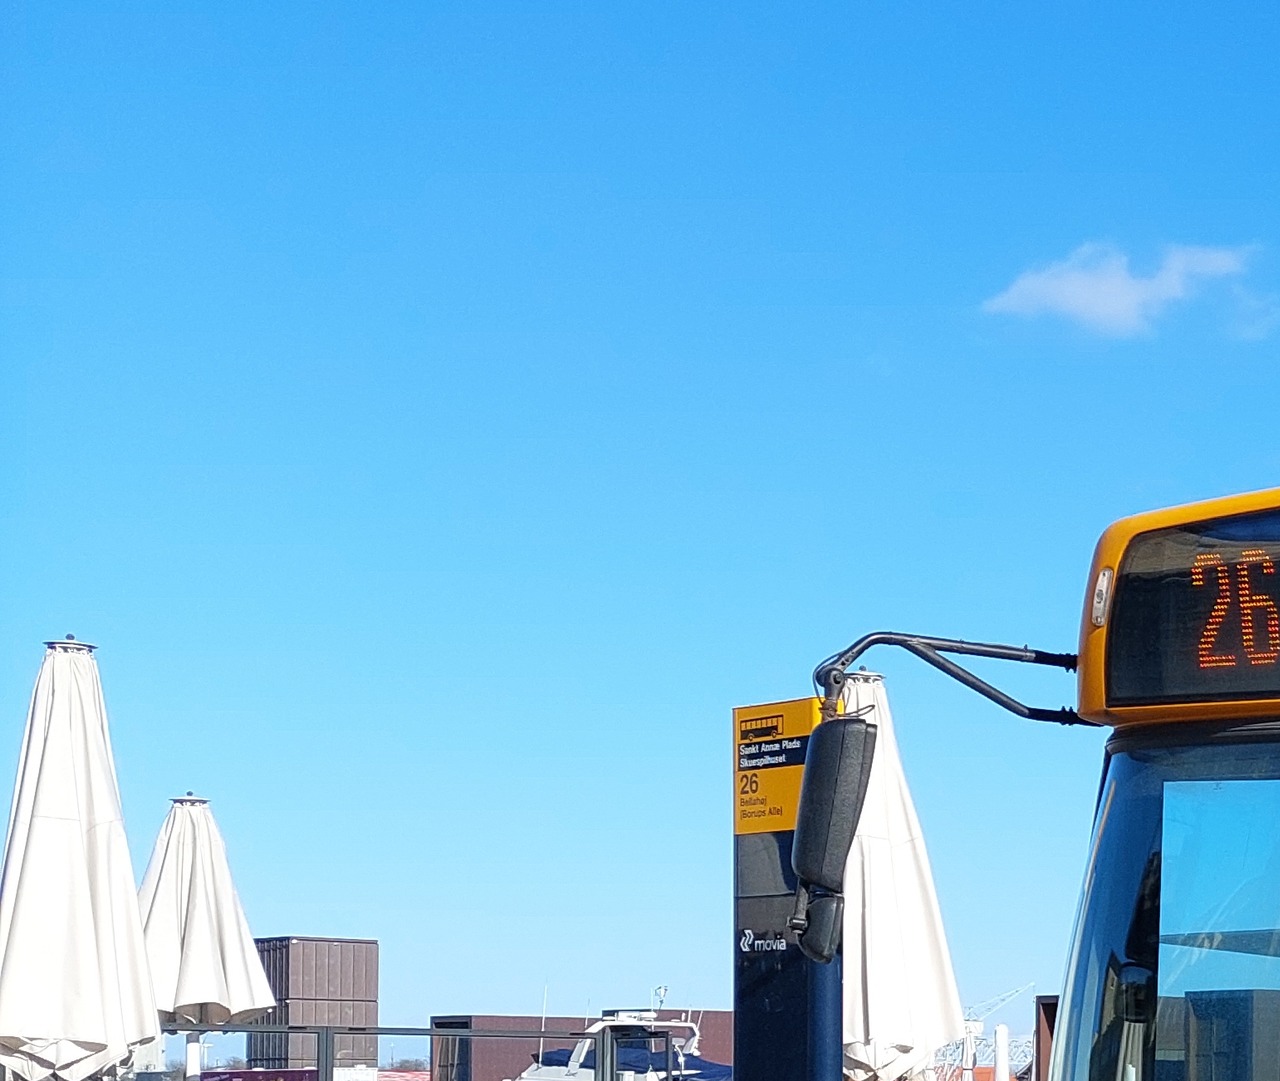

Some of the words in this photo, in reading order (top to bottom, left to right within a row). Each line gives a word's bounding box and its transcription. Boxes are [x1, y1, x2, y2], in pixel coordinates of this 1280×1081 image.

[739, 744, 759, 755] Sankt
[782, 739, 801, 750] Plads
[740, 772, 759, 795] 26
[754, 935, 787, 951] movia
